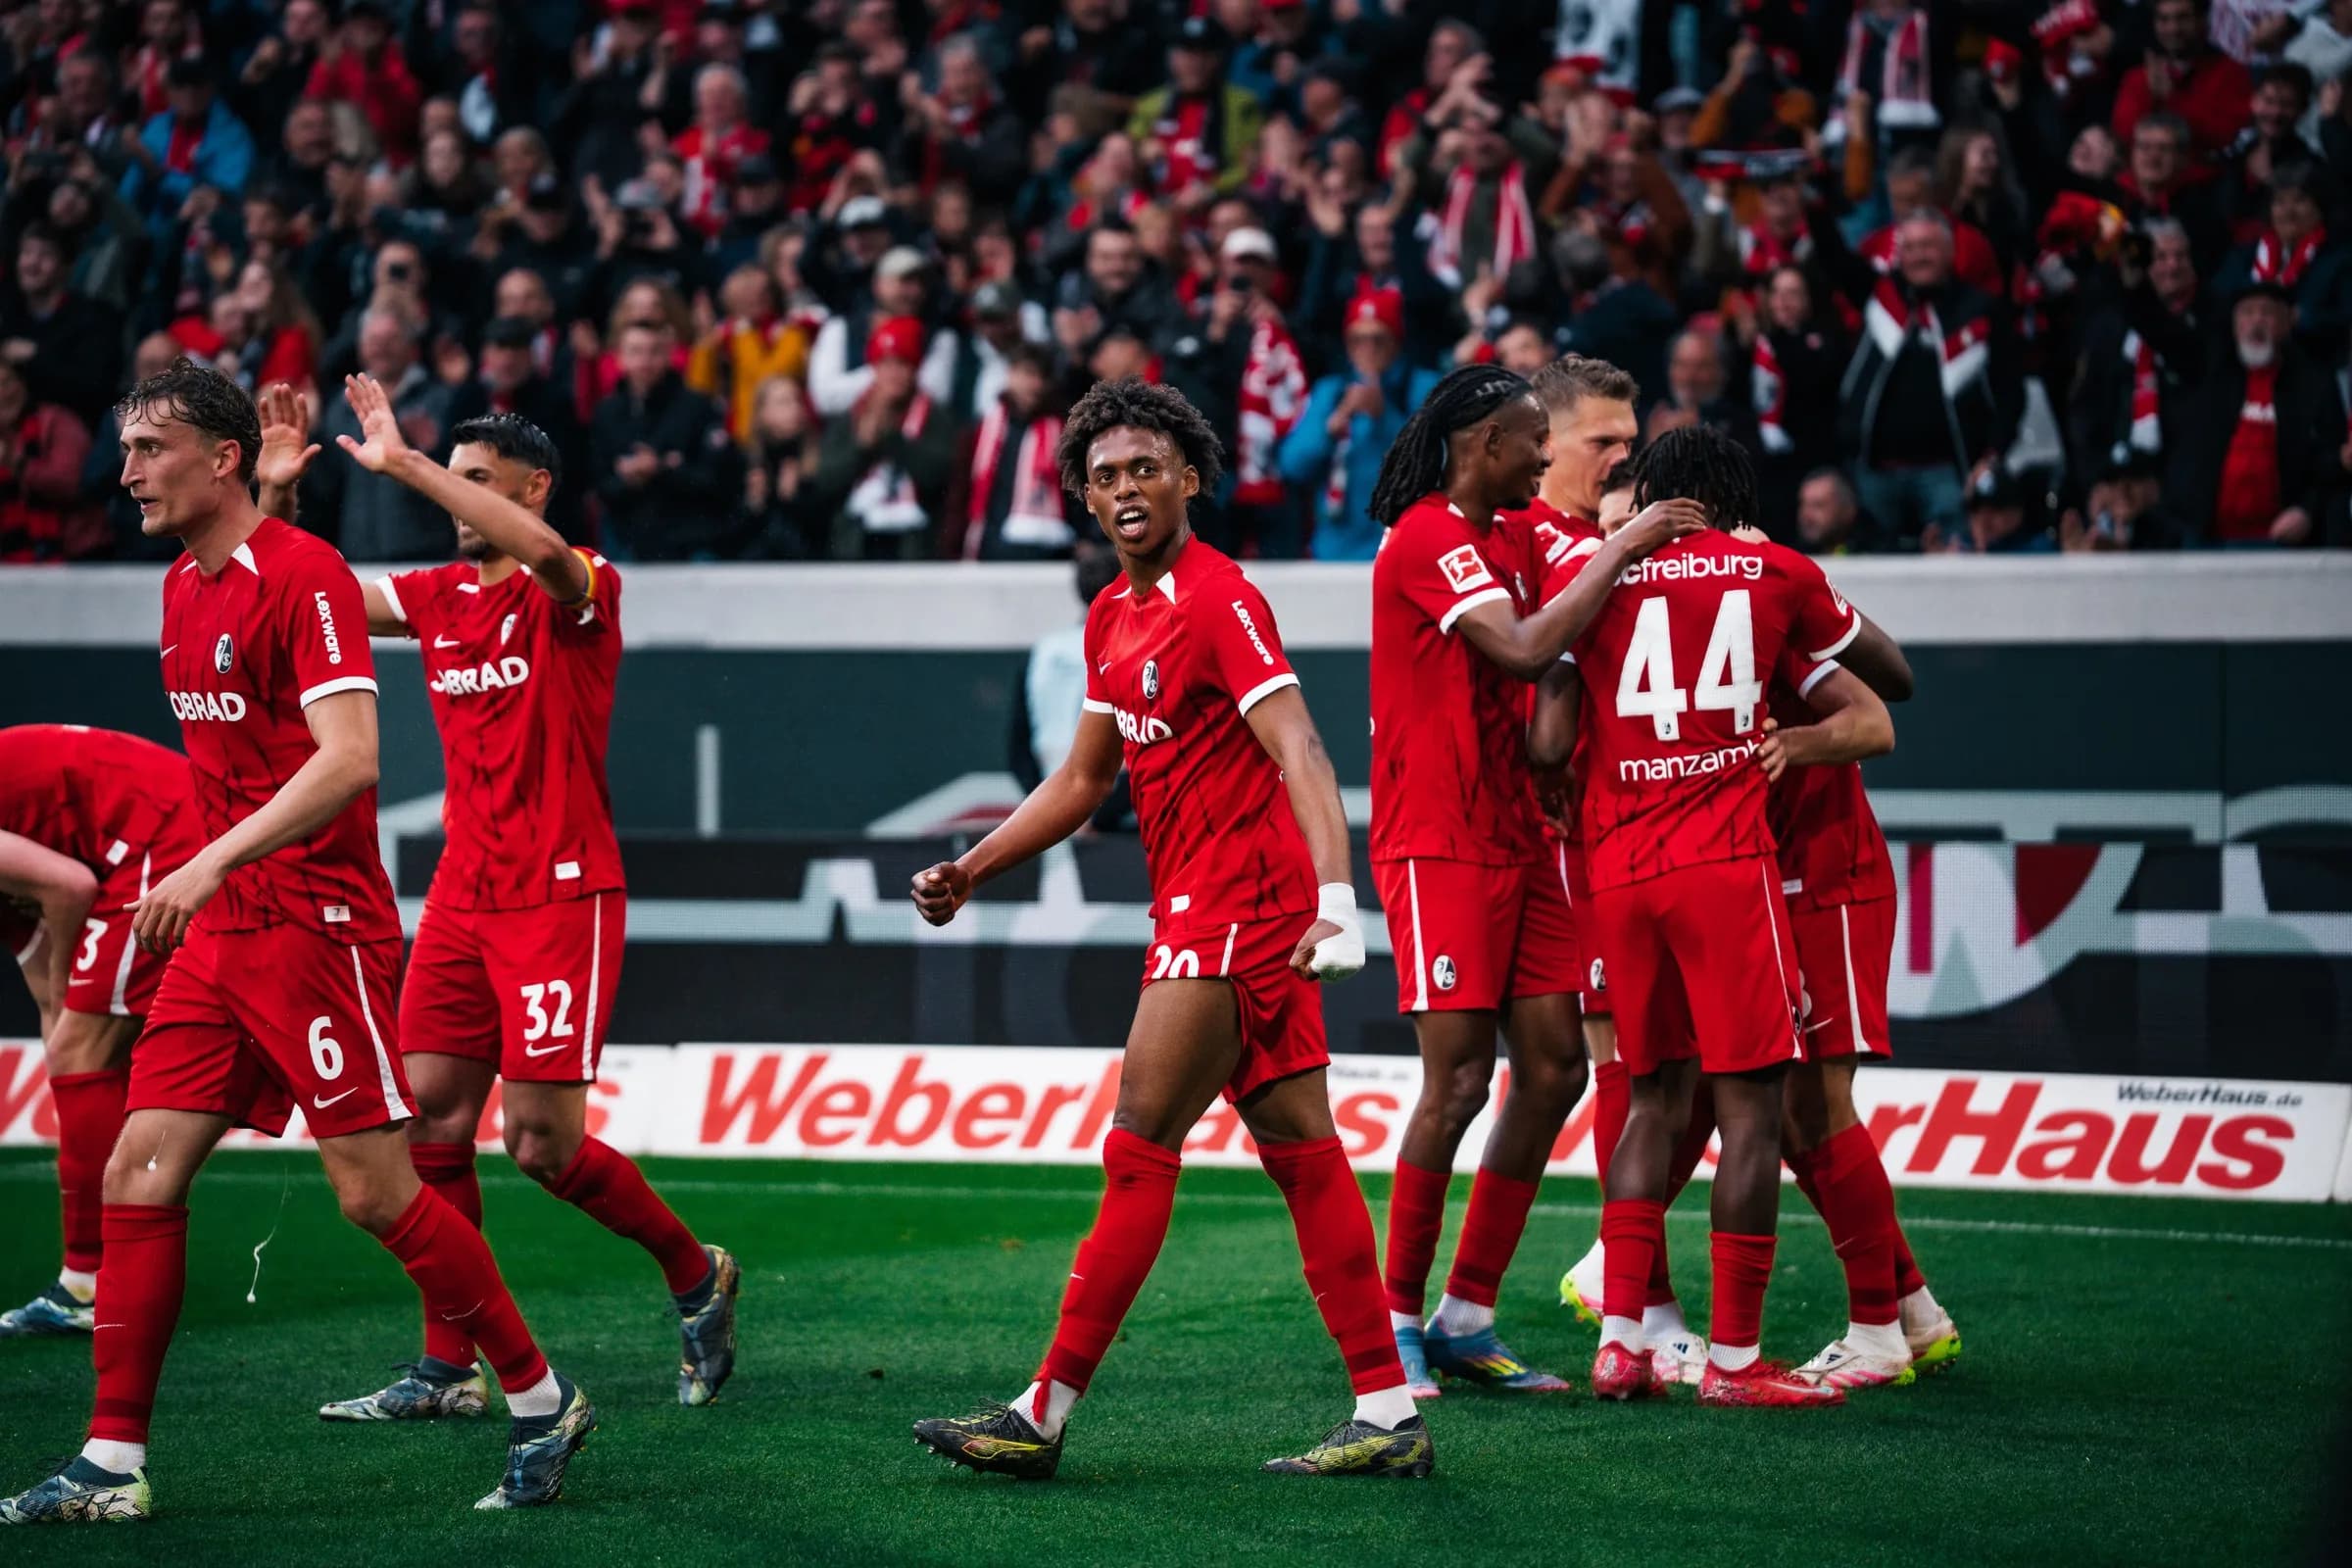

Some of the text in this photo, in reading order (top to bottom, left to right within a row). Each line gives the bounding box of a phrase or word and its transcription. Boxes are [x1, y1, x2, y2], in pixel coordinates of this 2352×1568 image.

[314, 591, 342, 665] Lexware
[1231, 600, 1274, 665] Lexware
[1615, 589, 1763, 742] 44
[169, 691, 247, 722] OBRAD
[520, 979, 574, 1041] 32
[308, 1015, 344, 1080] 6
[2117, 1081, 2304, 1109] WeberHaus.de
